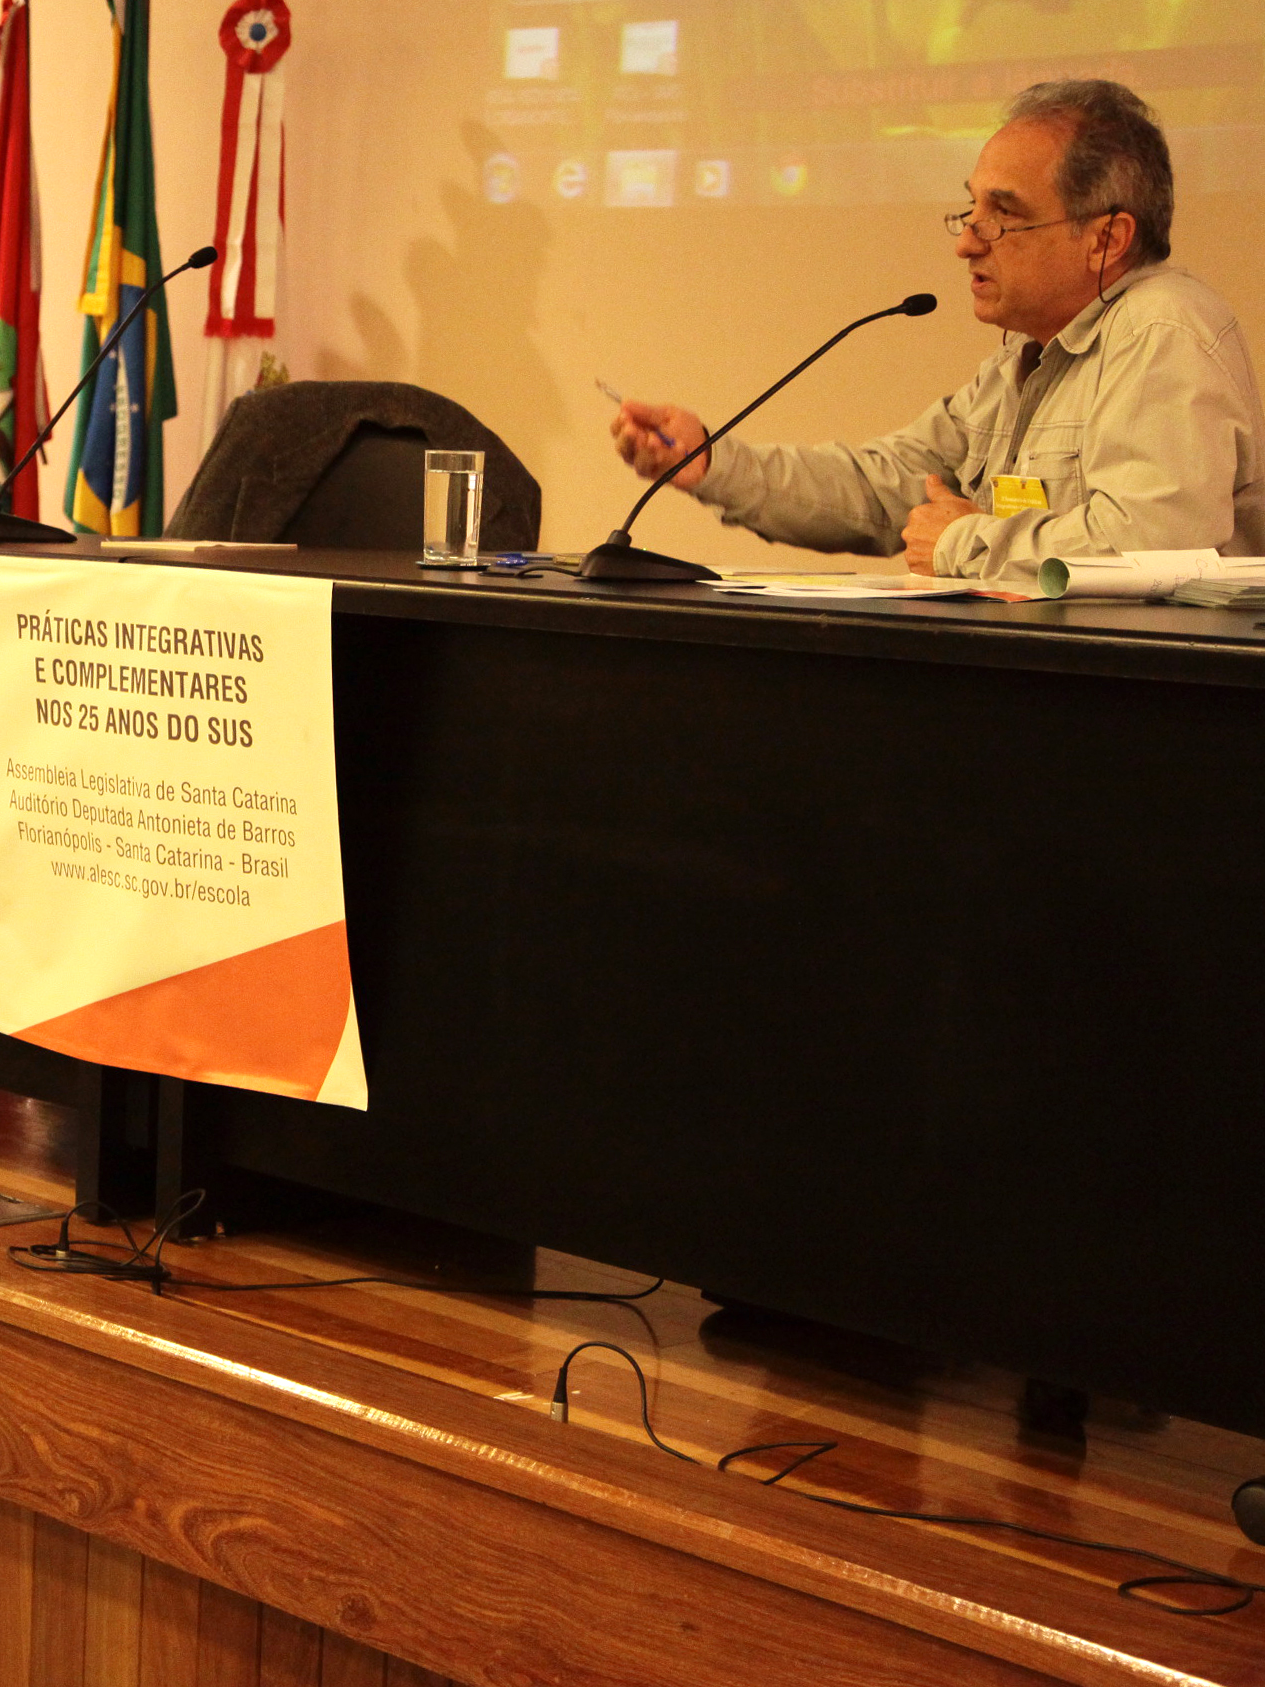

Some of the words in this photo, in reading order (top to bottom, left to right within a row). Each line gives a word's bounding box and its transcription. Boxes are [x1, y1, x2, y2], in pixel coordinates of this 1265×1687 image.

[16, 609, 108, 648] PRÁTICAS
[115, 621, 265, 663] INTEGRATIVAS
[35, 657, 46, 683] E
[52, 658, 248, 704] COMPLEMENTARES
[36, 698, 73, 728] NOS
[78, 704, 100, 732] 25
[105, 707, 159, 740] ANOS
[167, 713, 199, 743] DO
[208, 716, 253, 748] SUS
[6, 758, 77, 788] Assembleia
[81, 768, 151, 799] Legislativa
[156, 779, 175, 801] de
[181, 781, 227, 807] Santa
[232, 786, 298, 816] Catarina
[9, 789, 68, 817] Auditório
[72, 802, 134, 828] Deputada
[137, 809, 211, 838] Antonieta
[216, 817, 236, 840] de
[243, 820, 296, 847] Barros
[17, 821, 102, 853] Florianópolis
[115, 836, 151, 863] Santa
[156, 843, 223, 872] Catarina
[242, 853, 289, 879] Brasil
[51, 860, 251, 907] www.alesc.sc.gov.br/escola
